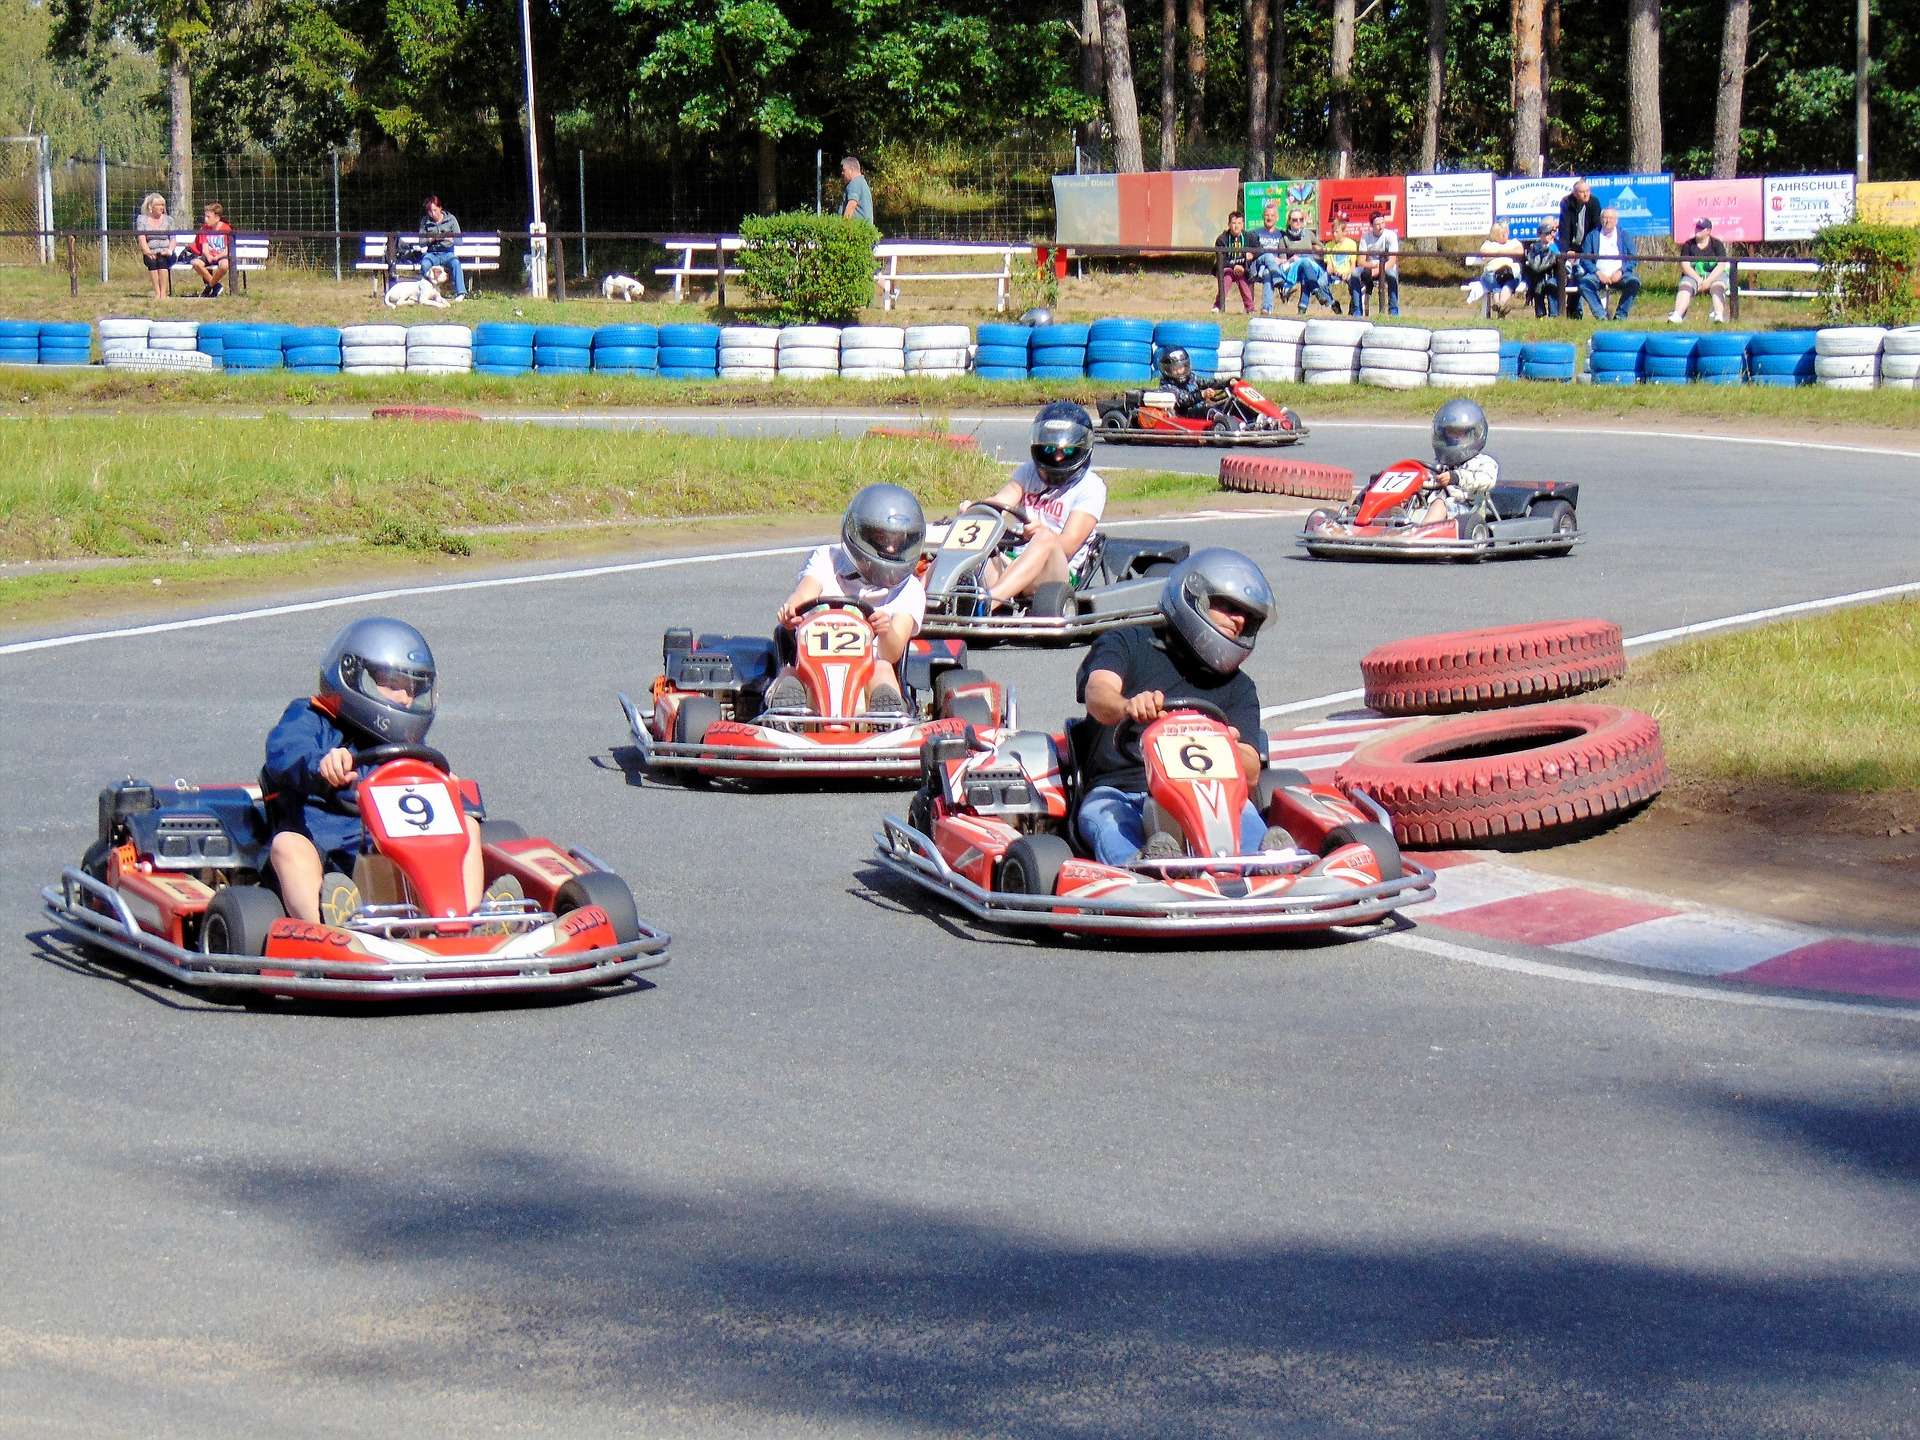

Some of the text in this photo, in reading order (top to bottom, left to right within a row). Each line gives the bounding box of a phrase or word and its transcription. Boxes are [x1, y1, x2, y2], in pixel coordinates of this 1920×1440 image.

[1771, 180, 1847, 192] FAHRSCHULE
[1382, 475, 1411, 489] 17
[959, 525, 981, 544] 3
[813, 631, 861, 651] 12
[1180, 744, 1213, 771] 6
[398, 793, 435, 826] 9
